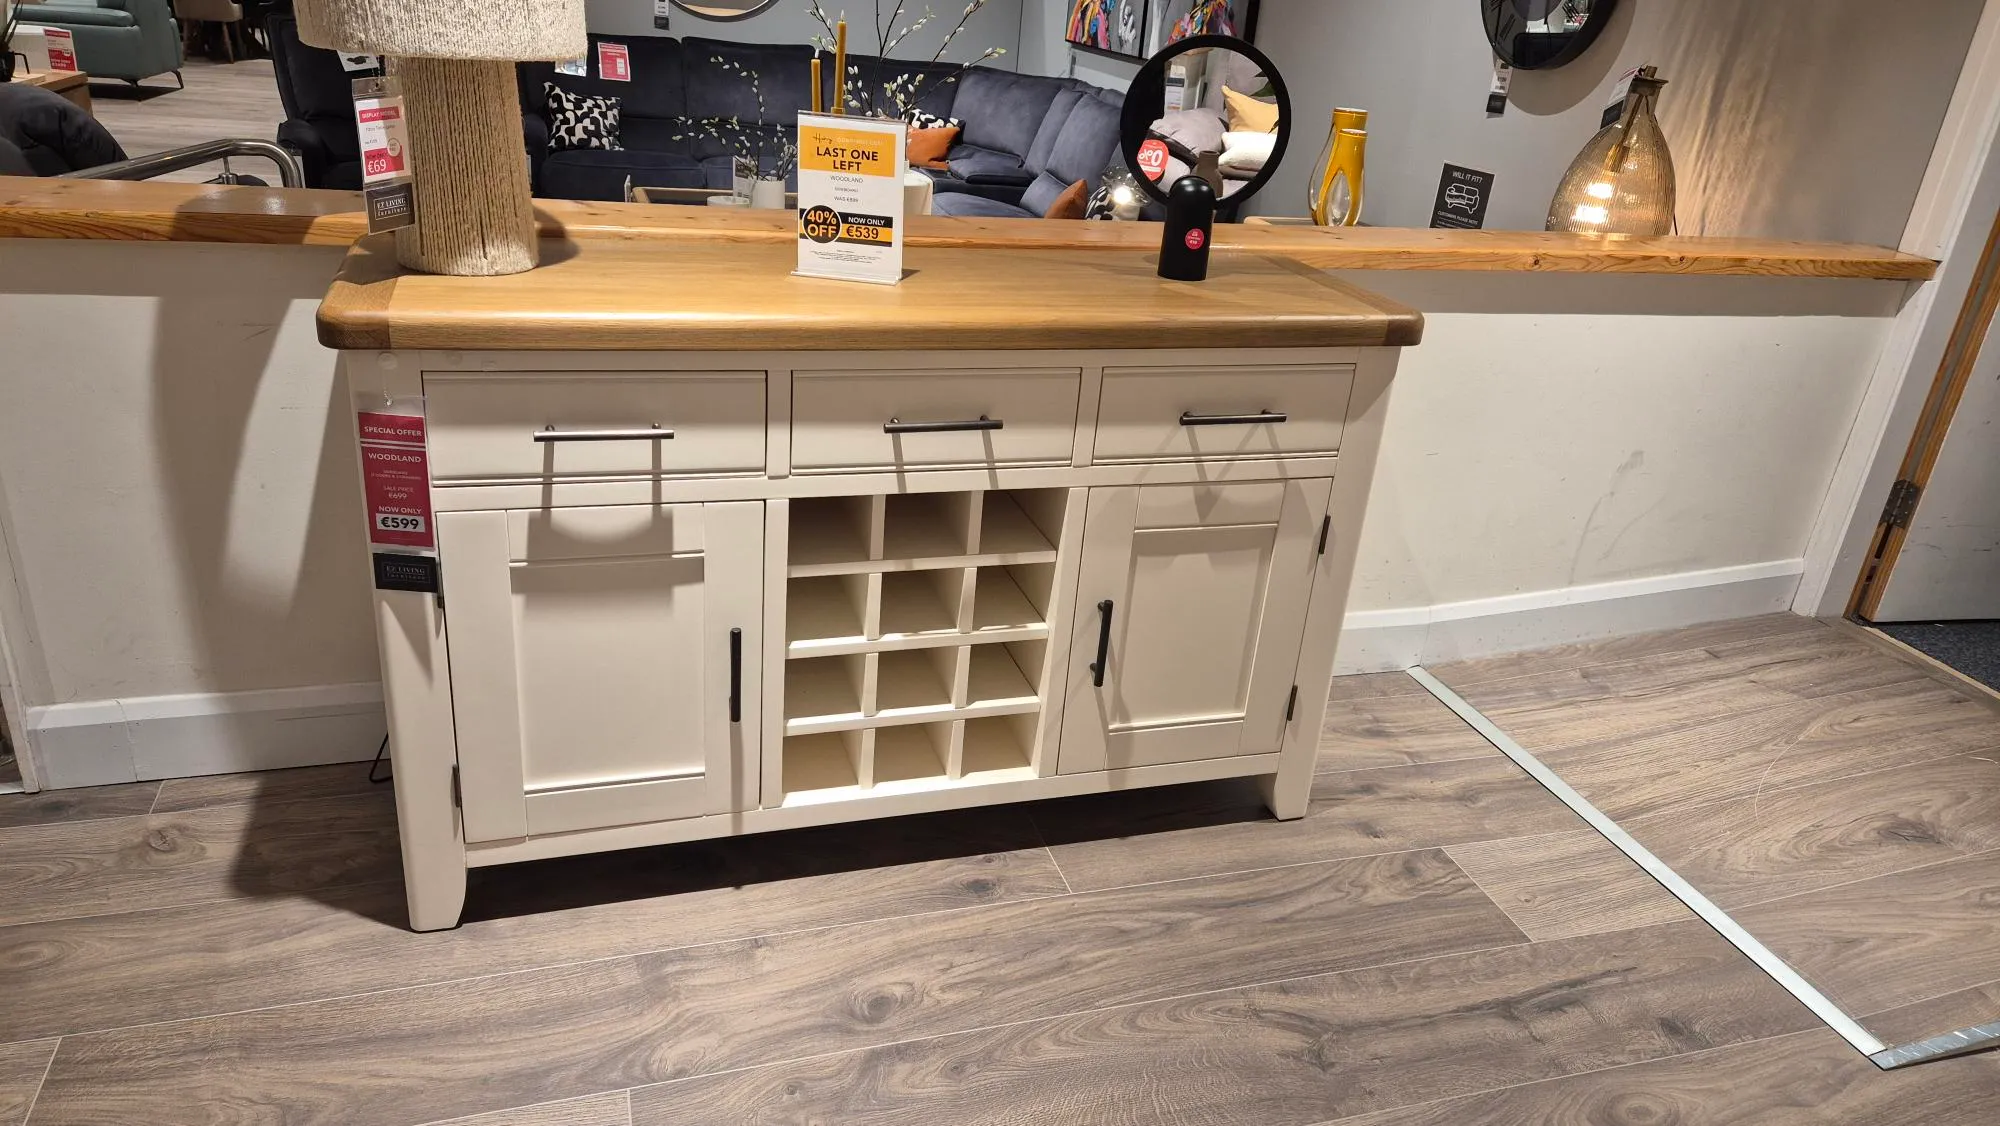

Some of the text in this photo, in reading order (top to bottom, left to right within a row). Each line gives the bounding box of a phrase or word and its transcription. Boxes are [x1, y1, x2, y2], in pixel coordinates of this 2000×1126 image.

[816, 146, 879, 161] LAST ONE
[368, 158, 387, 173] €69
[833, 160, 862, 171] LEFT
[830, 175, 864, 184] WOODLAND
[1453, 171, 1465, 180] WILL
[1471, 175, 1483, 184] FIT?
[386, 197, 406, 207] LIVING
[377, 207, 407, 217] furniture
[807, 210, 837, 225] 40%
[848, 216, 885, 226] NOW ONLY
[807, 223, 837, 238] OFF
[846, 225, 879, 240] €539
[364, 425, 422, 437] SPECIAL OFFER
[368, 452, 422, 463] WOODLAND
[379, 505, 422, 515] NOW ONLY
[381, 516, 419, 530] €599
[398, 565, 425, 574] LIVING
